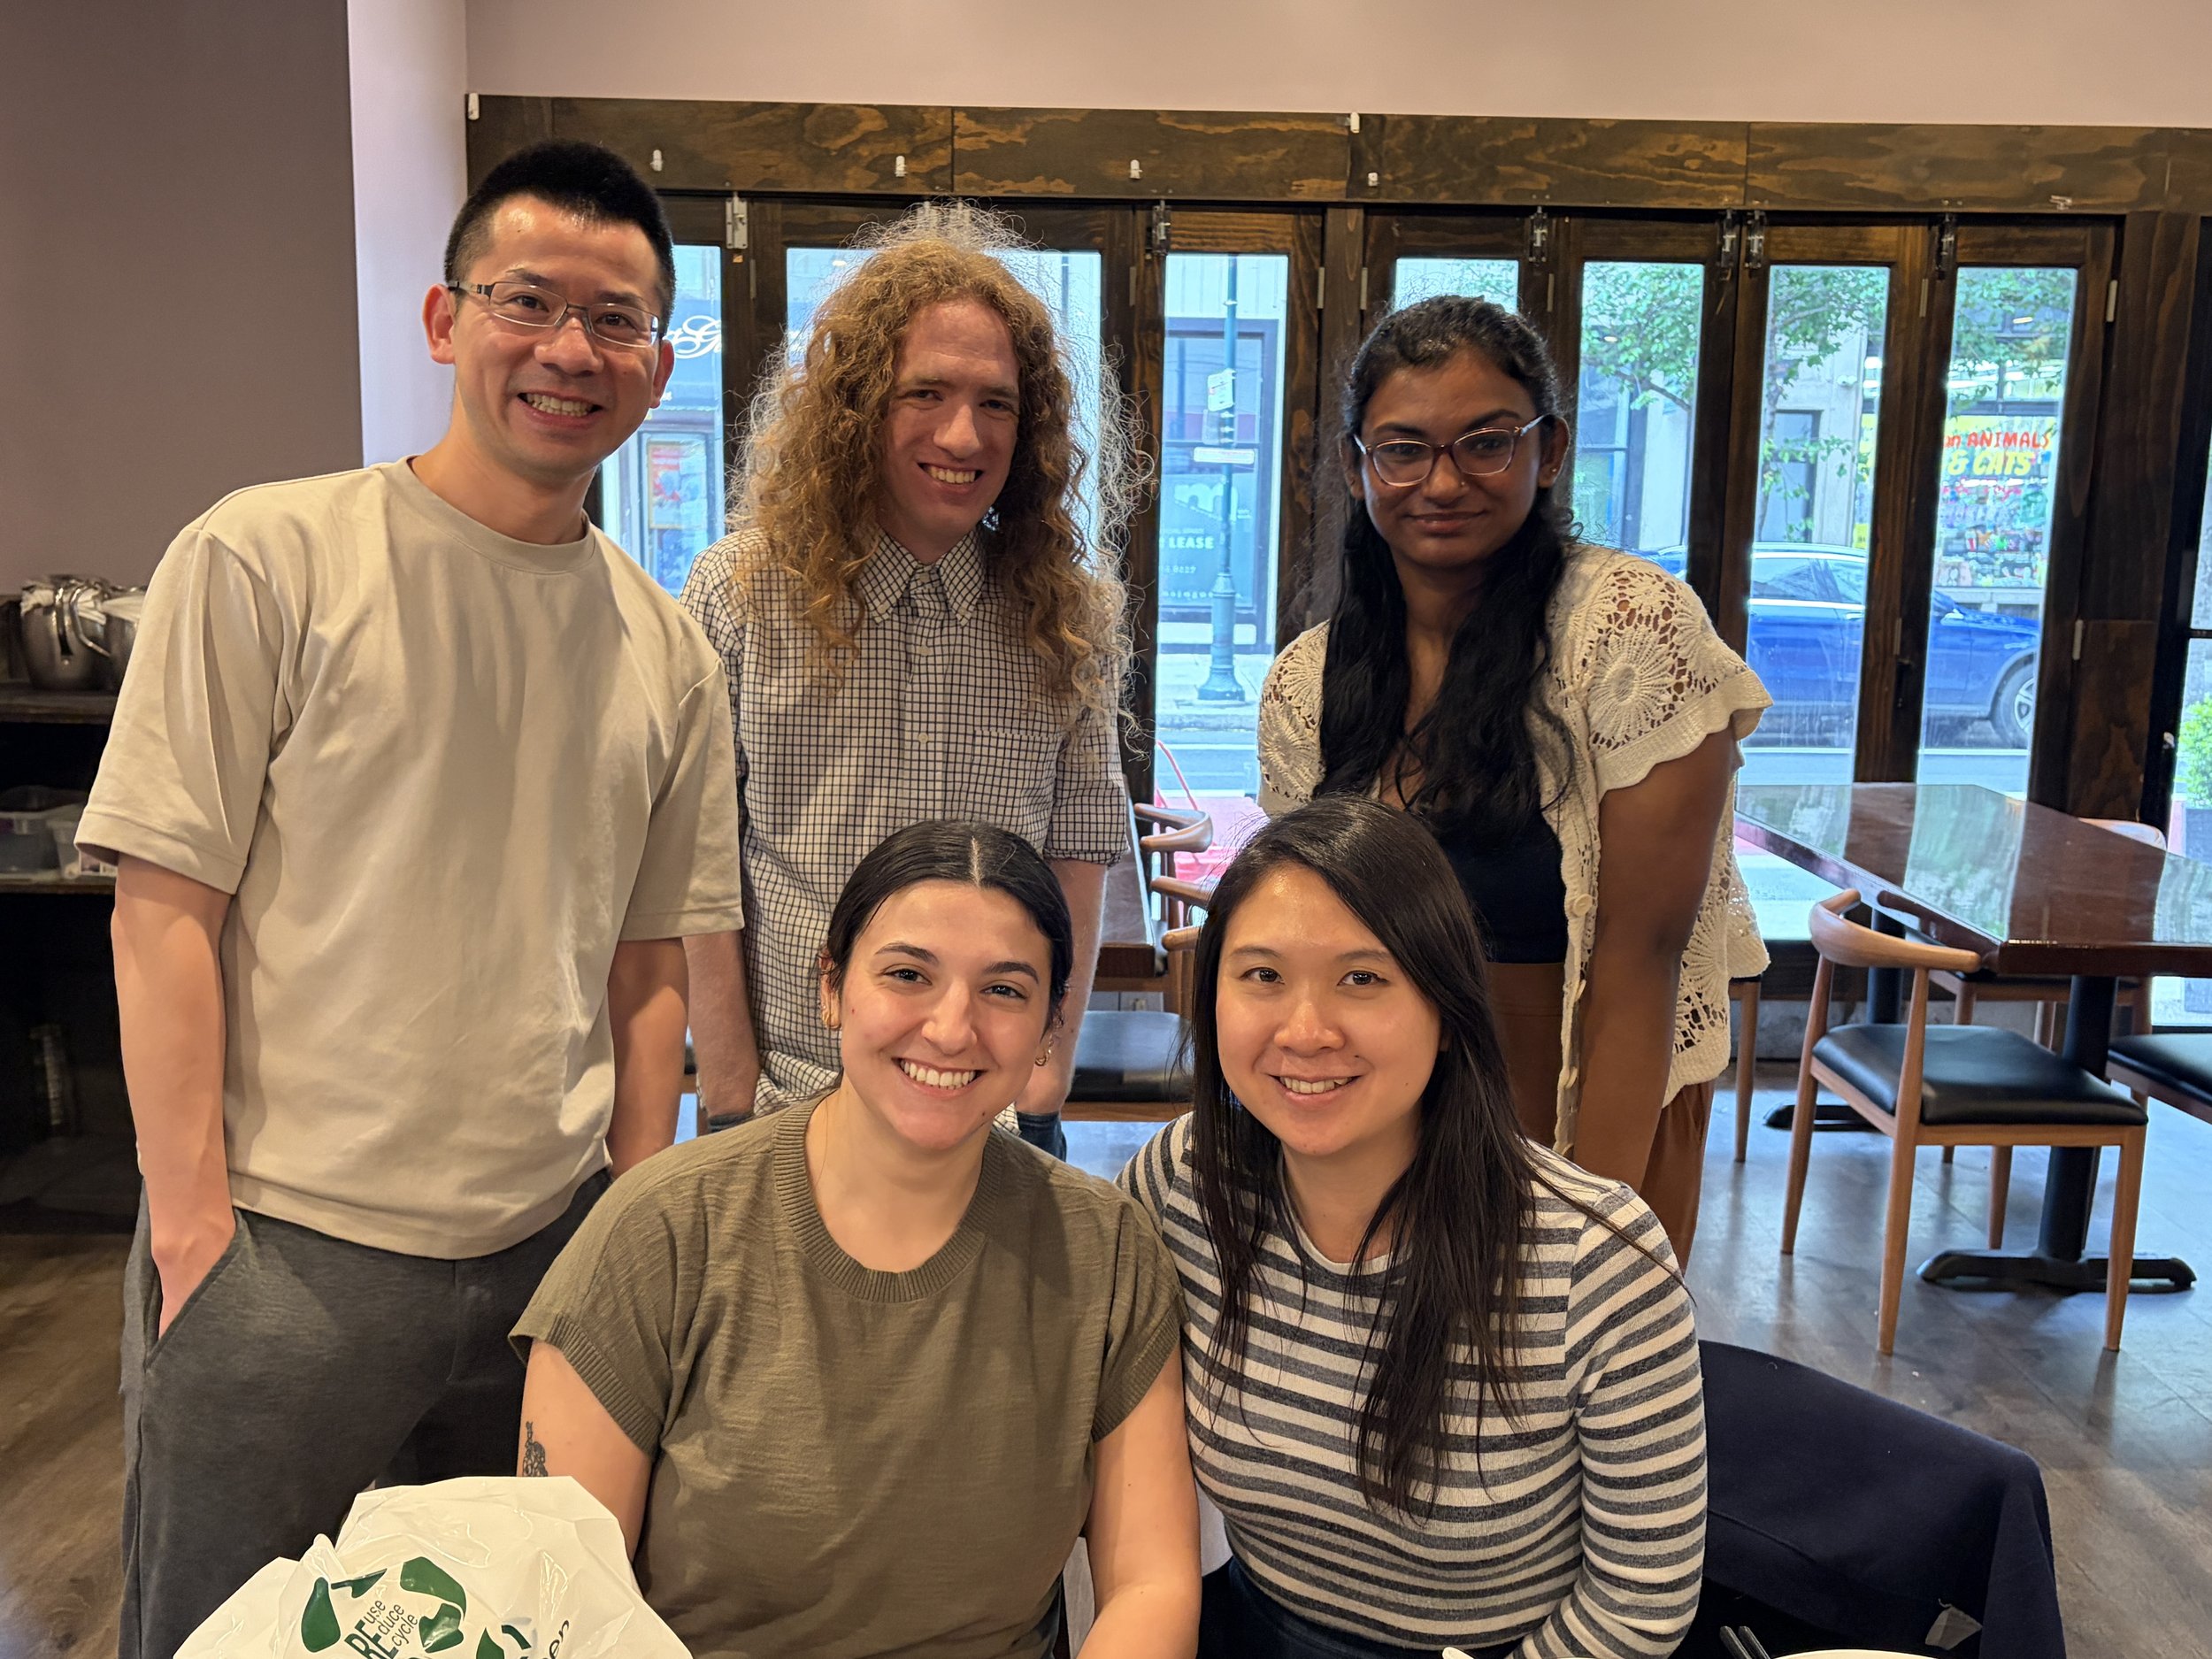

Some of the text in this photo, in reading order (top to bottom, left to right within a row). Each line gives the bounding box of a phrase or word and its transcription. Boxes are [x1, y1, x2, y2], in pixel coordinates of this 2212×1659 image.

[1967, 431, 2049, 449] ANIMALS
[1948, 450, 2034, 475] & CATS
[1169, 536, 1215, 549] LEASE
[378, 1604, 404, 1635] duce
[391, 1614, 419, 1647] cycle
